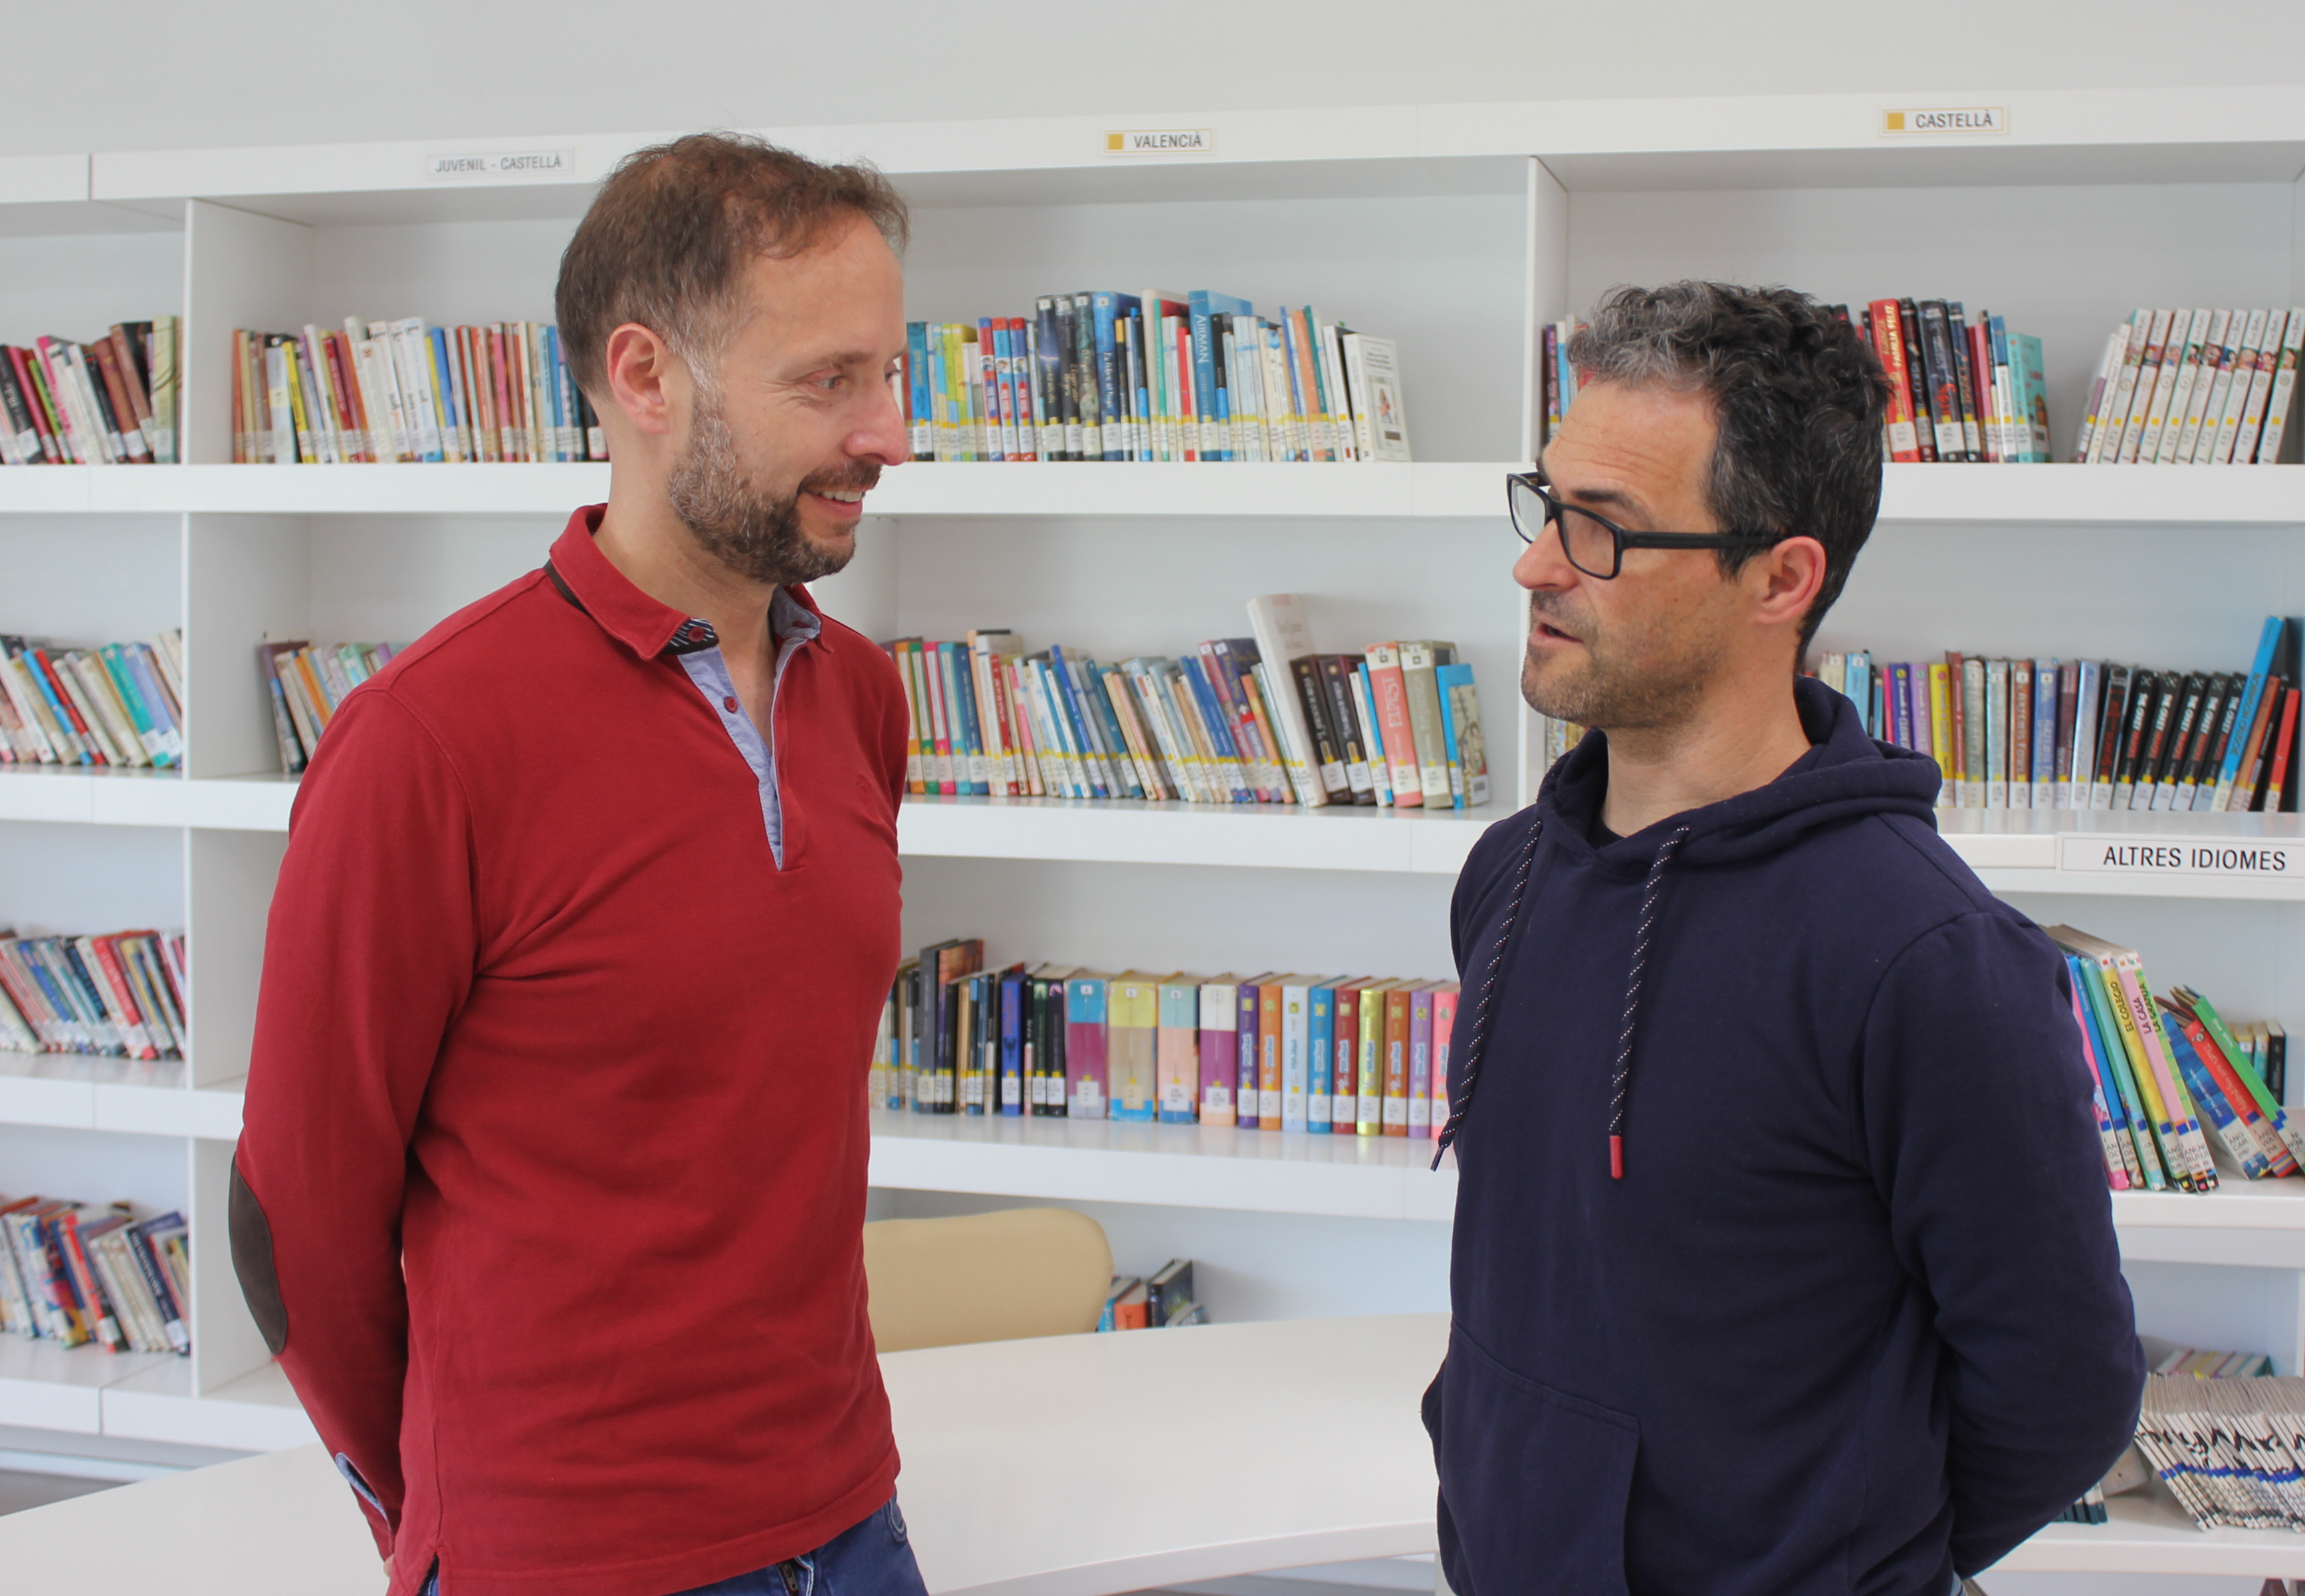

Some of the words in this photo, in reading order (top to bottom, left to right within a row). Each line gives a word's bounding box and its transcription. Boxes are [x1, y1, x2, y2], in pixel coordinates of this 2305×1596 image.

[1916, 109, 1993, 128] CASTELLÀ
[1133, 131, 1202, 148] VALENCIÀ
[435, 158, 486, 173] JUVENIL
[500, 153, 561, 170] CASTELLÀ
[1194, 314, 1210, 364] AIRMAN
[2103, 846, 2182, 867] ALTRES
[2191, 848, 2286, 871] IDIOMES
[2110, 981, 2130, 1020] COLEGIO
[2133, 996, 2147, 1020] CASA
[2124, 1021, 2134, 1032] EL
[2142, 1022, 2151, 1034] LA
